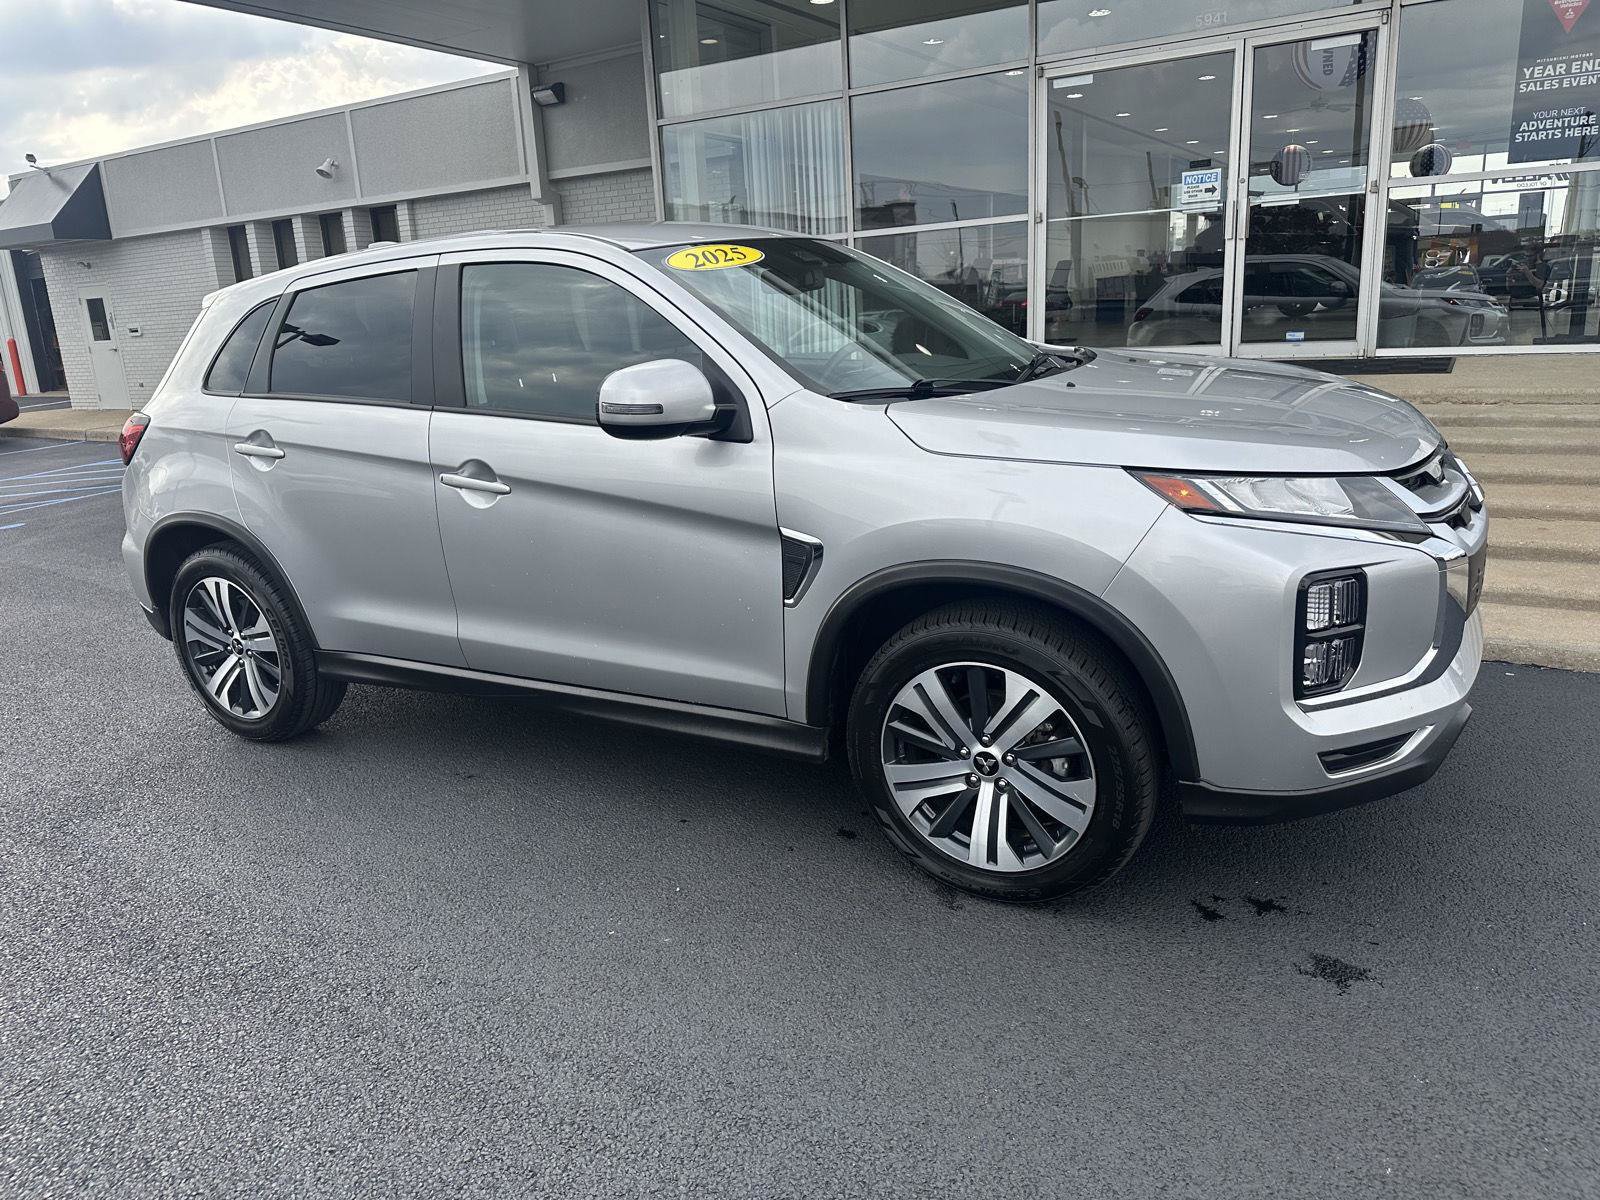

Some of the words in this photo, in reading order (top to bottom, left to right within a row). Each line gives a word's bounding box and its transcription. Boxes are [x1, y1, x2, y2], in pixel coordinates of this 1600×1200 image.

[1523, 63, 1567, 79] YEAR
[1519, 79, 1559, 93] SALES
[1562, 74, 1600, 88] EVEN
[1533, 109, 1558, 119] YOUR
[1560, 106, 1586, 116] NEXT
[1519, 114, 1597, 132] ADVENTURE
[1514, 129, 1562, 143] STARTS
[1564, 125, 1599, 138] HERE
[1185, 173, 1217, 185] NOTICE
[685, 247, 747, 268] 2025
